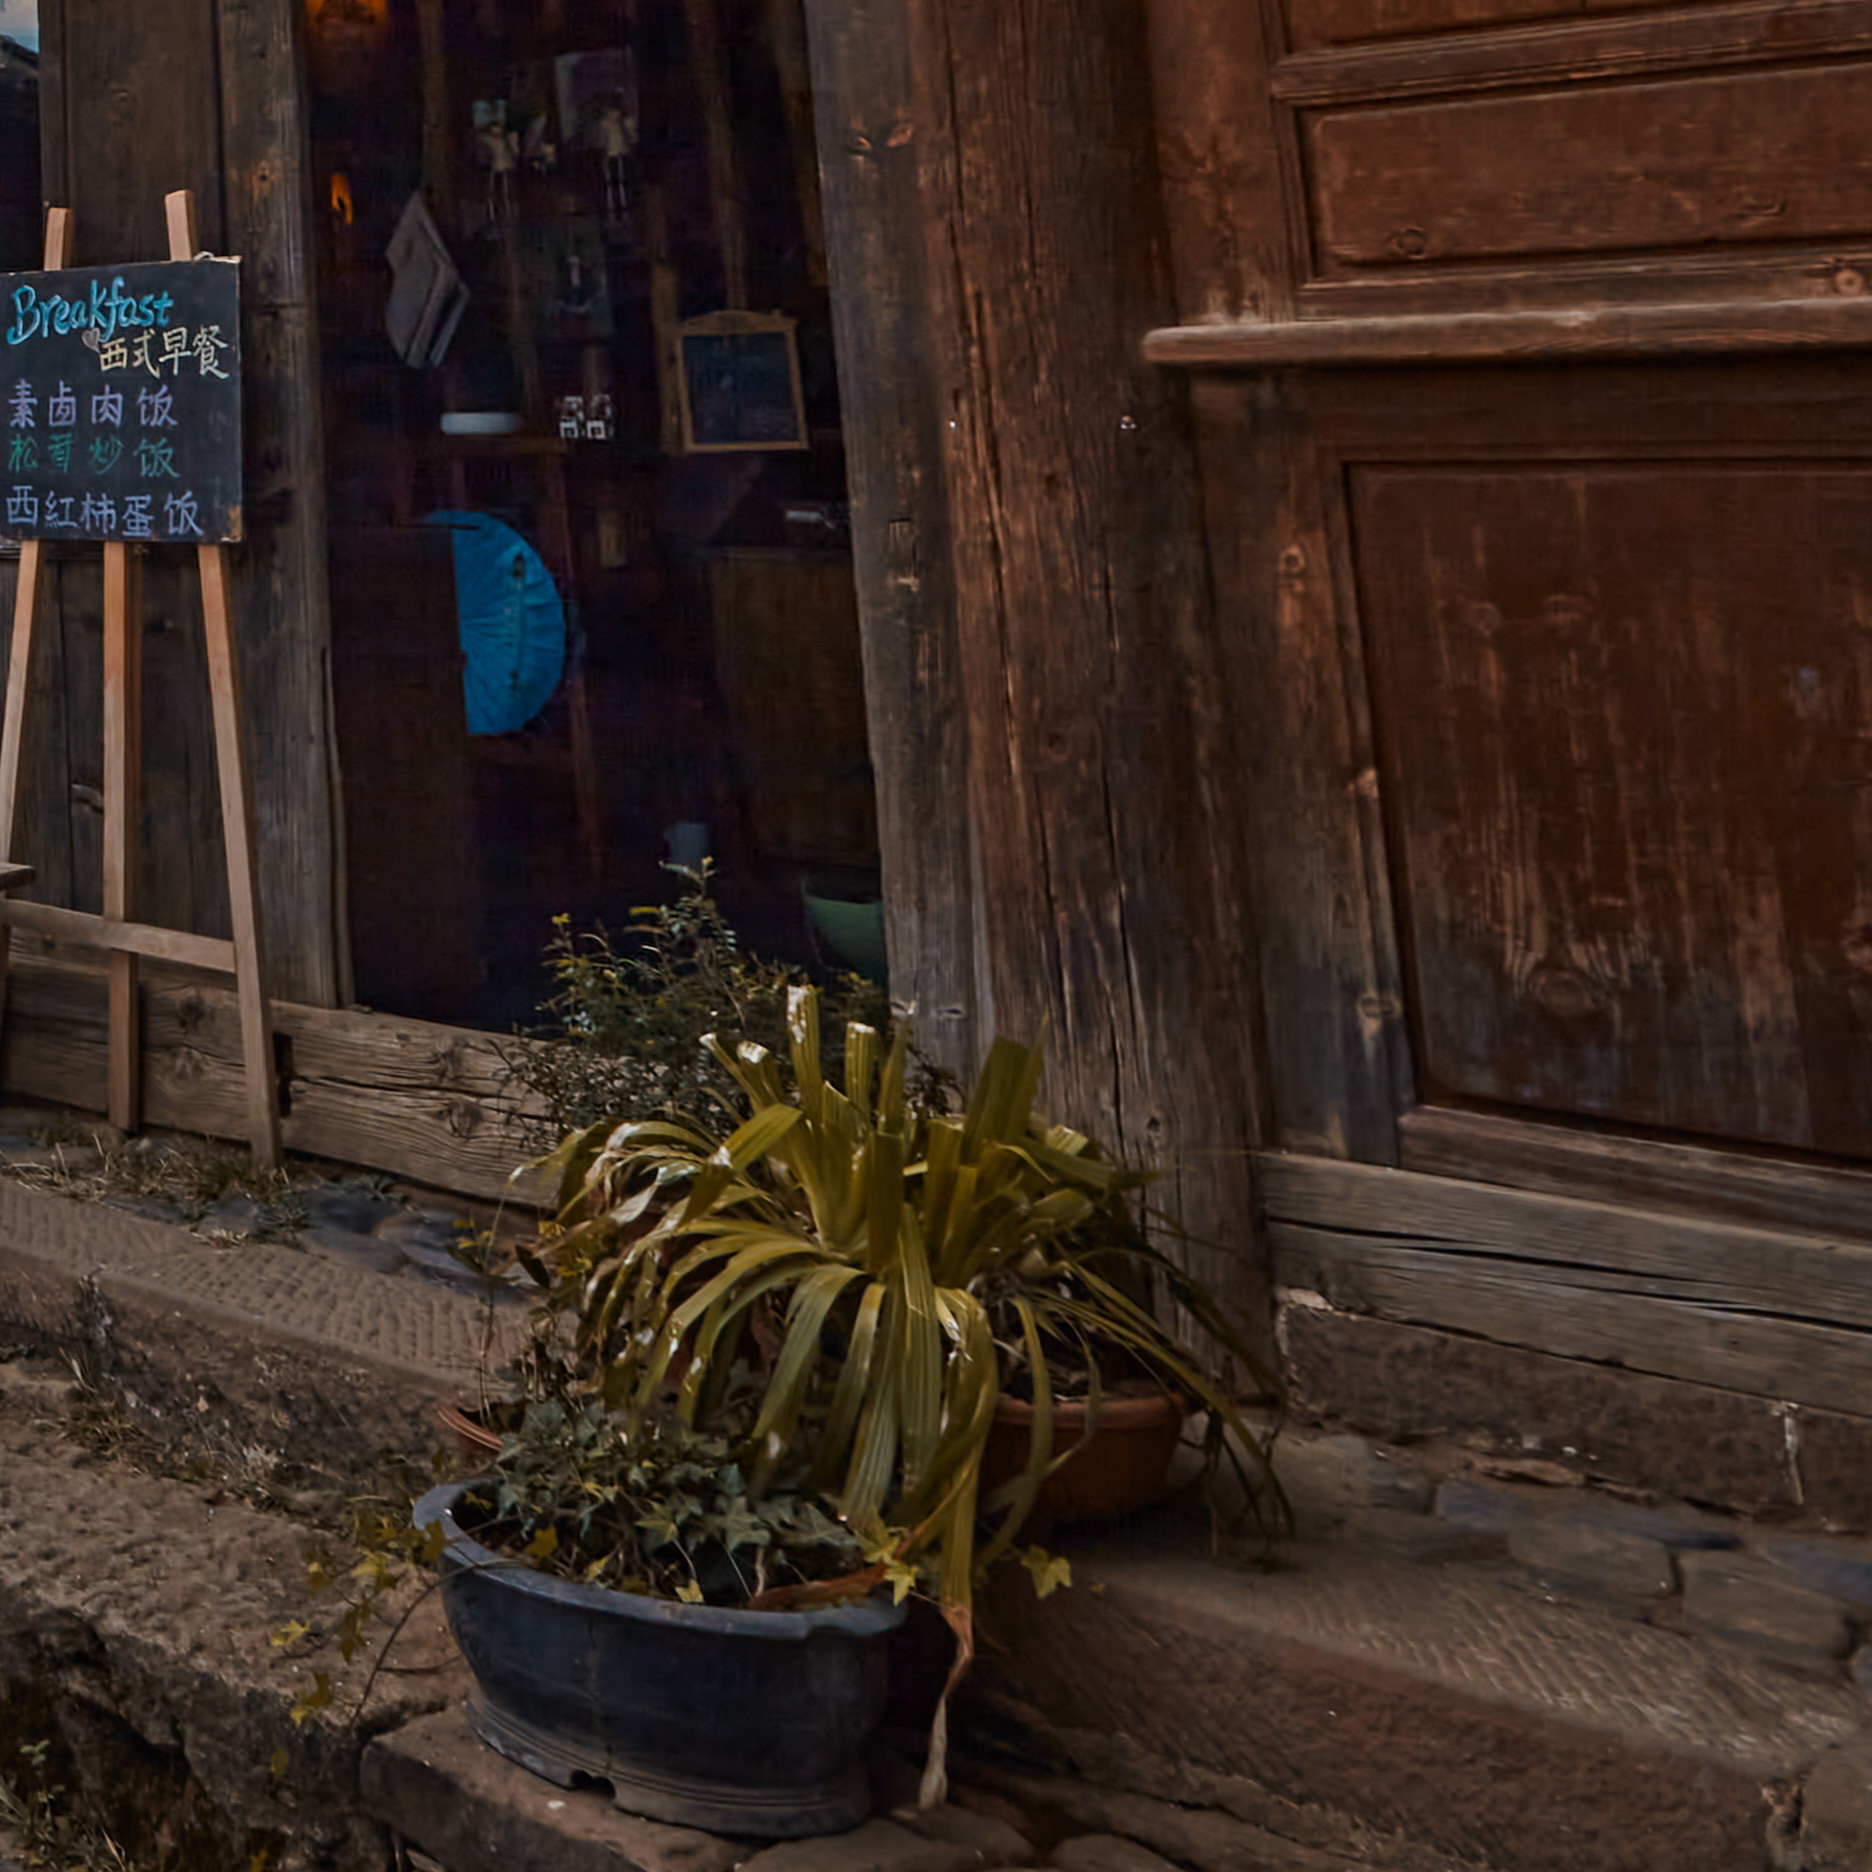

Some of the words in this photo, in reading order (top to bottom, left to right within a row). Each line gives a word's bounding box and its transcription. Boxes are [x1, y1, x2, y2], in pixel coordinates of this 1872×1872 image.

[6, 275, 175, 346] Breakfast
[99, 324, 230, 379] 西式早餐
[8, 379, 179, 429] 素卤肉饭
[8, 432, 182, 479] 松茸炒饭
